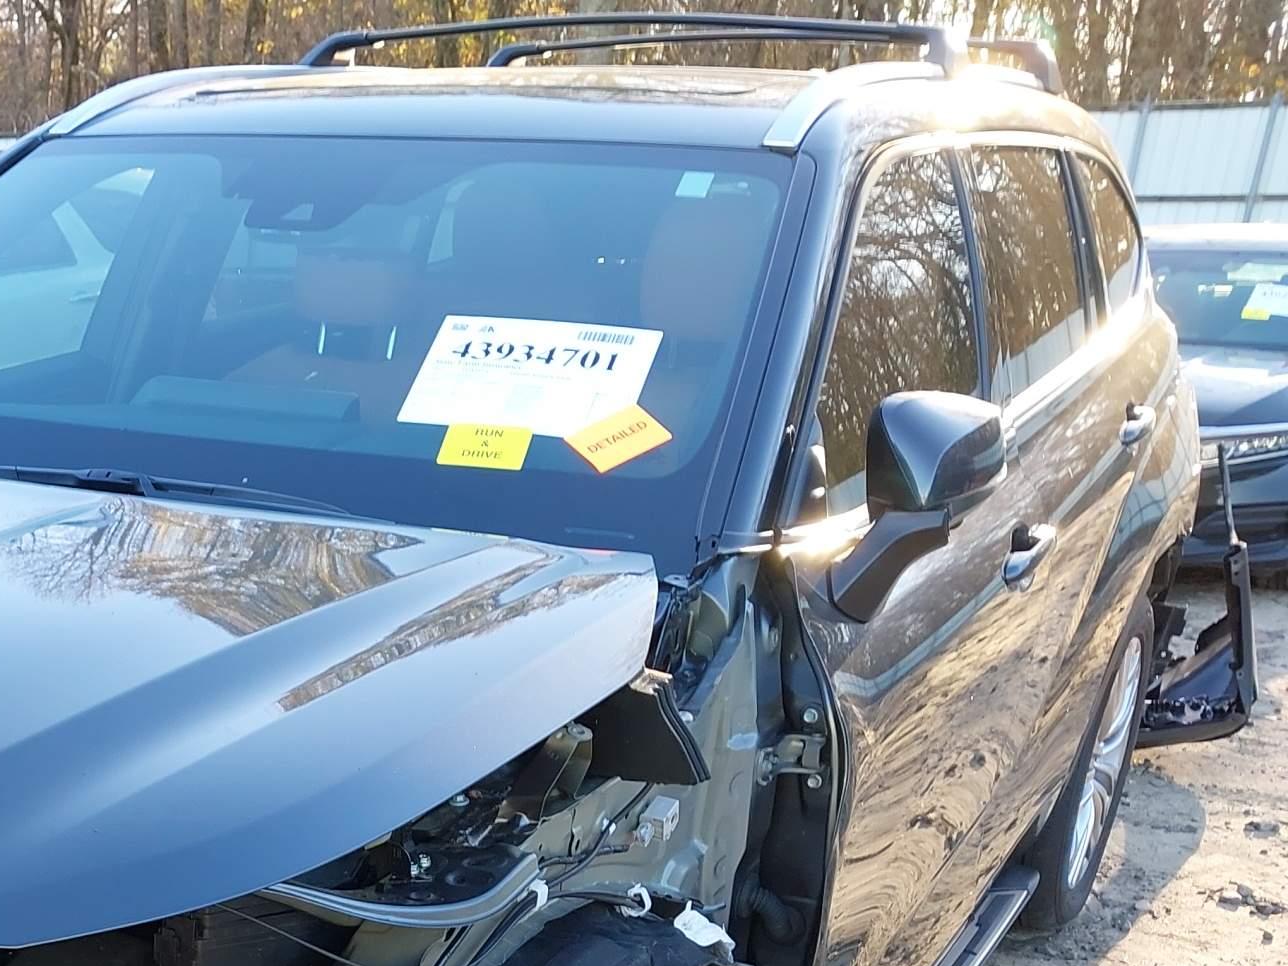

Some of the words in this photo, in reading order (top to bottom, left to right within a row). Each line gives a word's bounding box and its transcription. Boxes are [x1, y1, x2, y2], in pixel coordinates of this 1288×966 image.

[452, 340, 619, 371] 43934701
[474, 428, 504, 437] RUN
[587, 421, 648, 453] DETAILED
[461, 449, 503, 459] DRIVE
